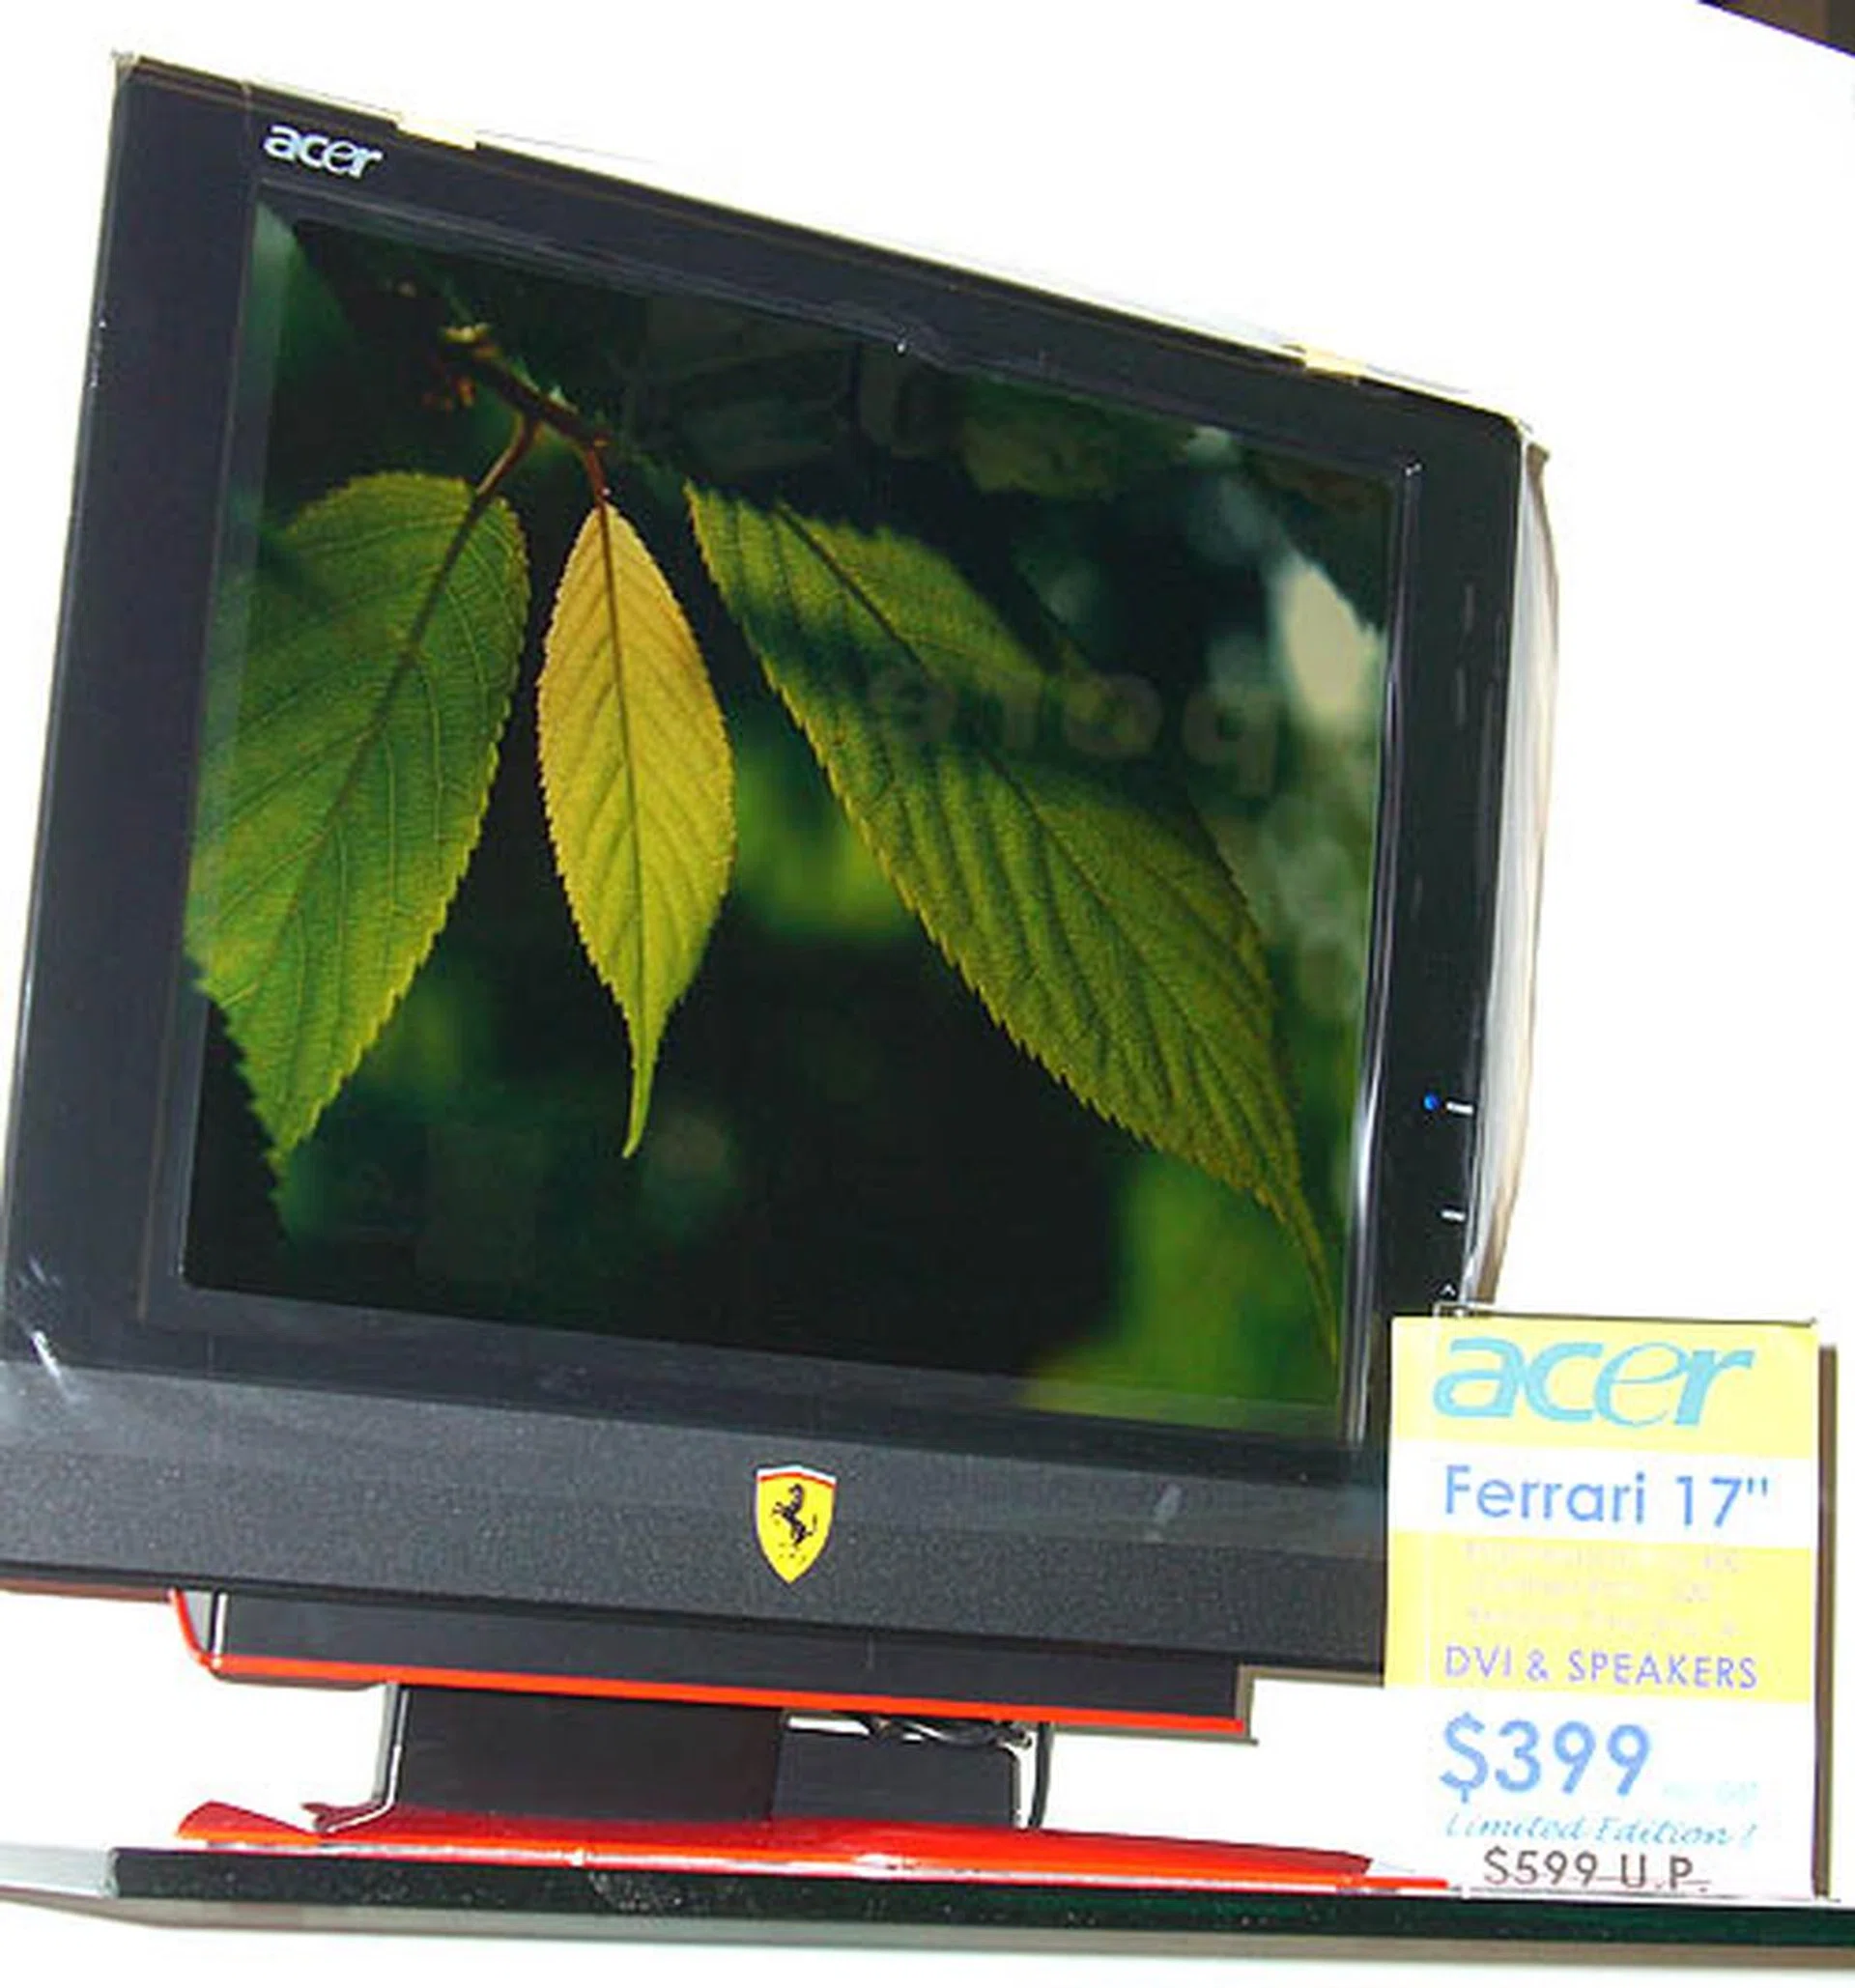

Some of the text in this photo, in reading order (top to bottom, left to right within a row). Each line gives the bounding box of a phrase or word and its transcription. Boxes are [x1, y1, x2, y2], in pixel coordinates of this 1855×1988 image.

[263, 124, 384, 178] acer
[1432, 1336, 1756, 1428] acer
[1444, 1463, 1771, 1528] Ferrari 17"
[1444, 1644, 1759, 1690] DVI & SPEAKERS
[1439, 1712, 1653, 1804] $399
[1444, 1812, 1585, 1839] Limited
[1483, 1845, 1599, 1889] $599
